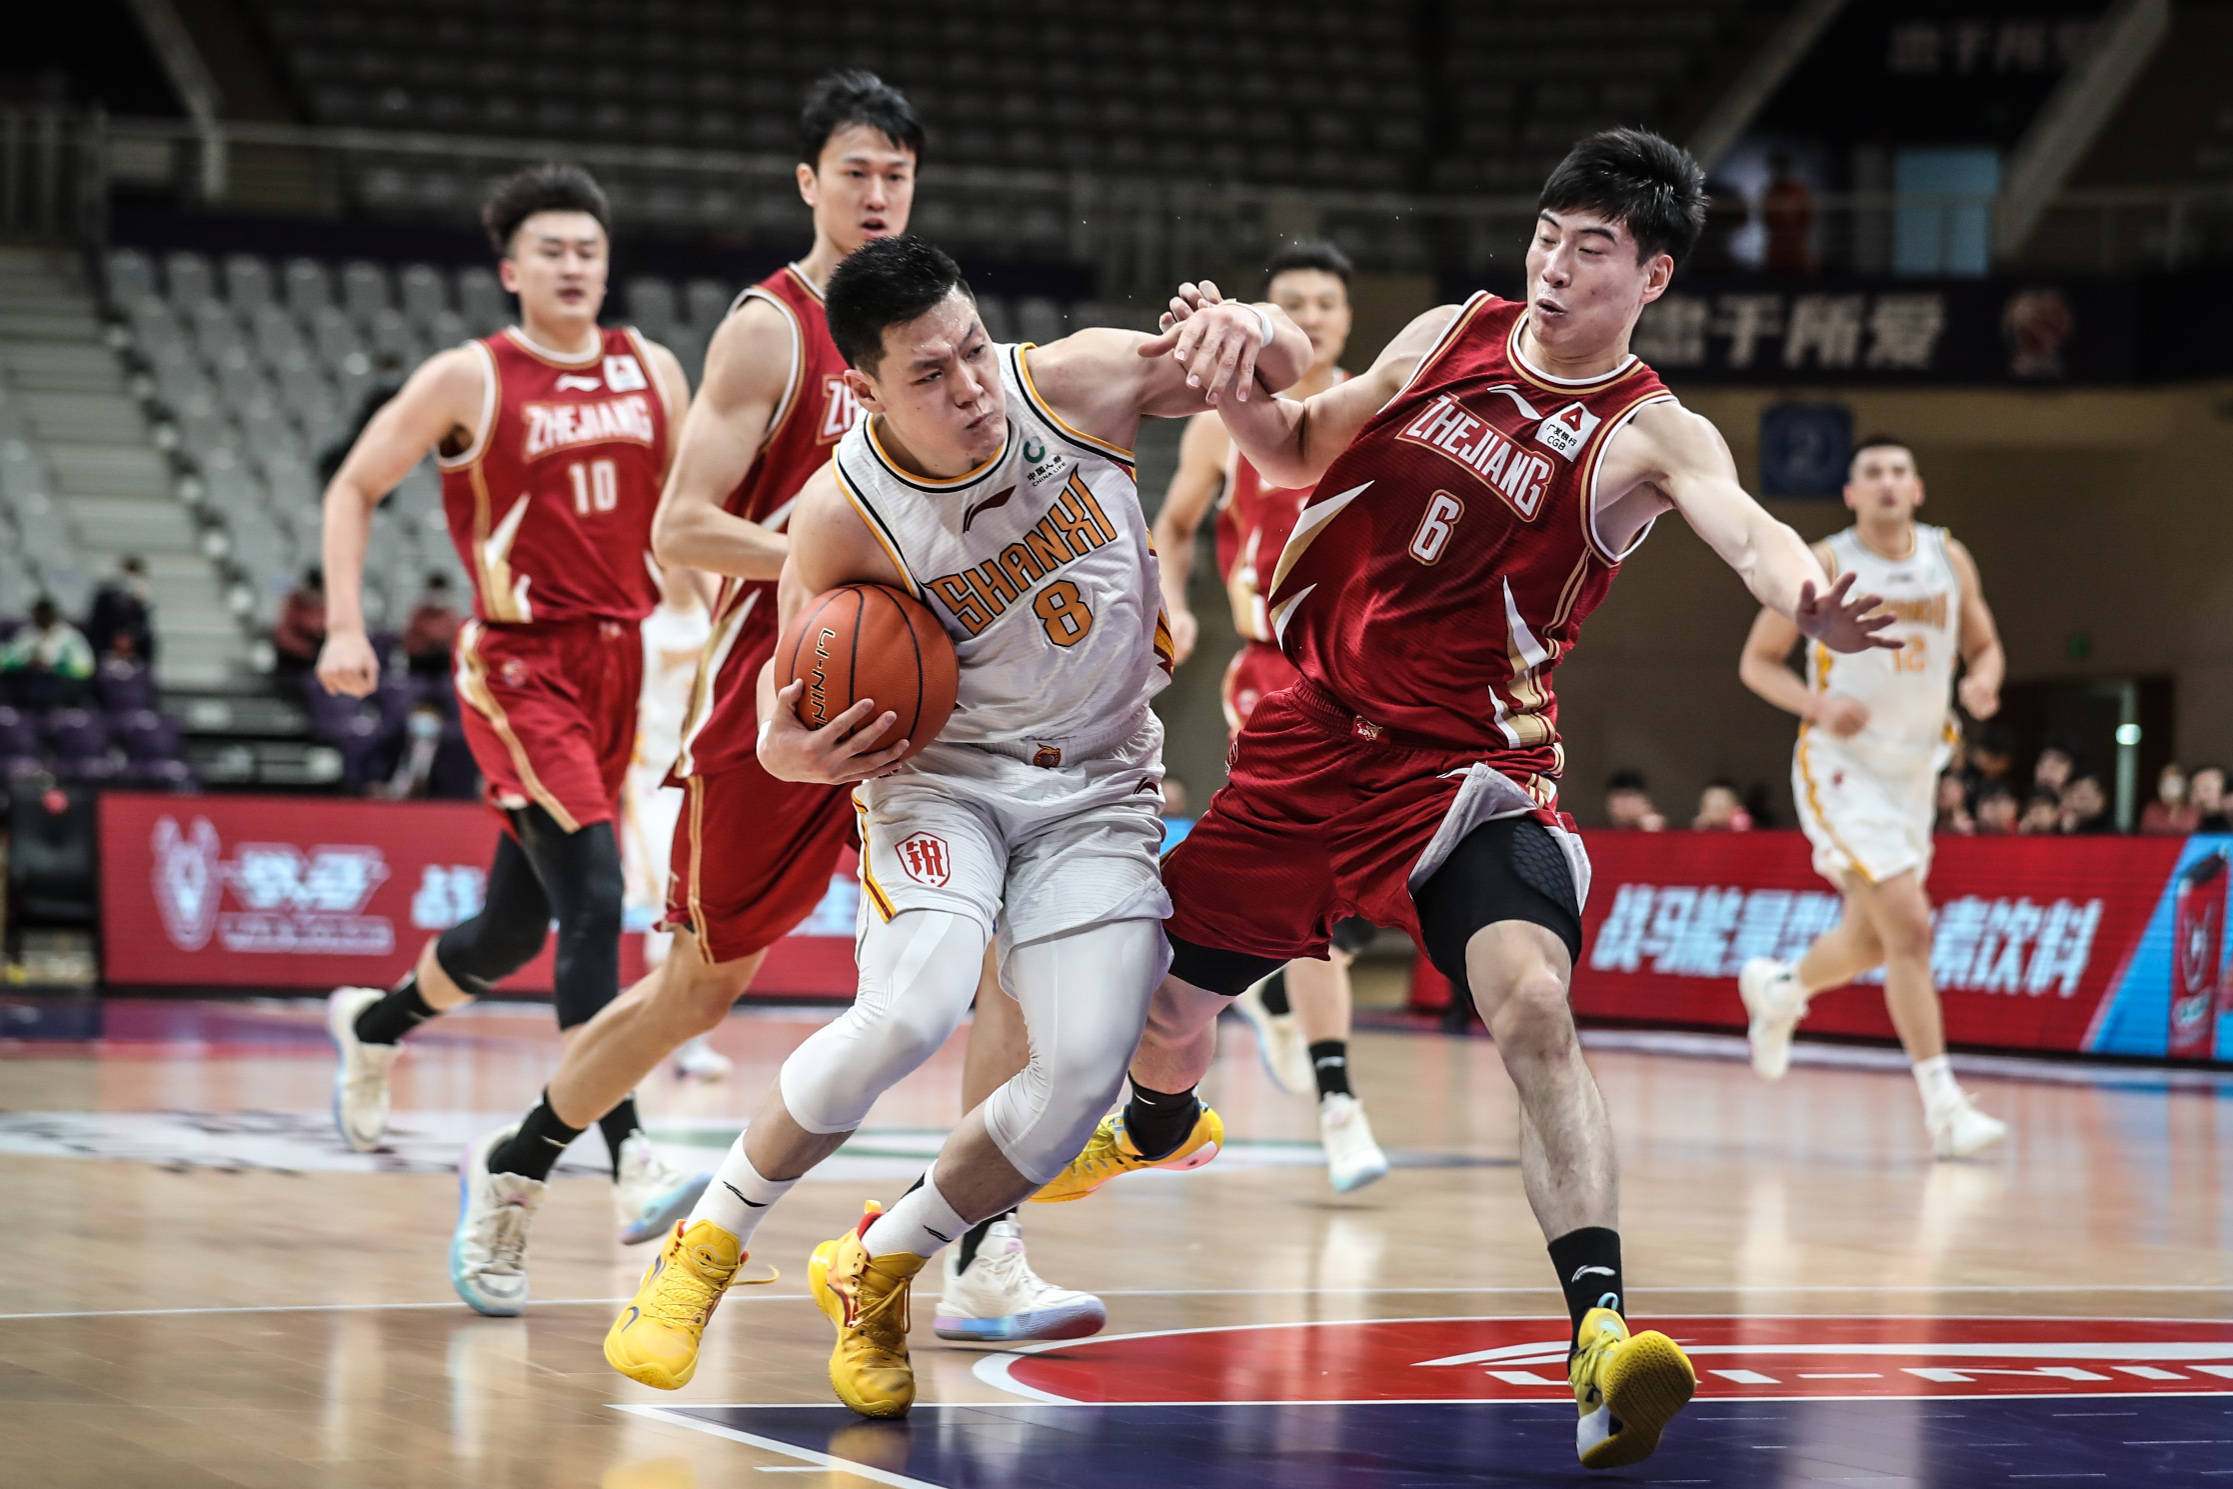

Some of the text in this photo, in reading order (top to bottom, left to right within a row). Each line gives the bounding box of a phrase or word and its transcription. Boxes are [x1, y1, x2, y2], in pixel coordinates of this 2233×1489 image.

[524, 393, 656, 456] ZHEJIANG
[1404, 393, 1551, 518] ZHEJIANG
[1546, 435, 1566, 451] CGB
[567, 459, 618, 515] 10
[1032, 472, 1053, 487] CHINA
[921, 462, 1119, 637] SHANXI
[1410, 491, 1463, 564] 6
[1031, 578, 1095, 648] 8
